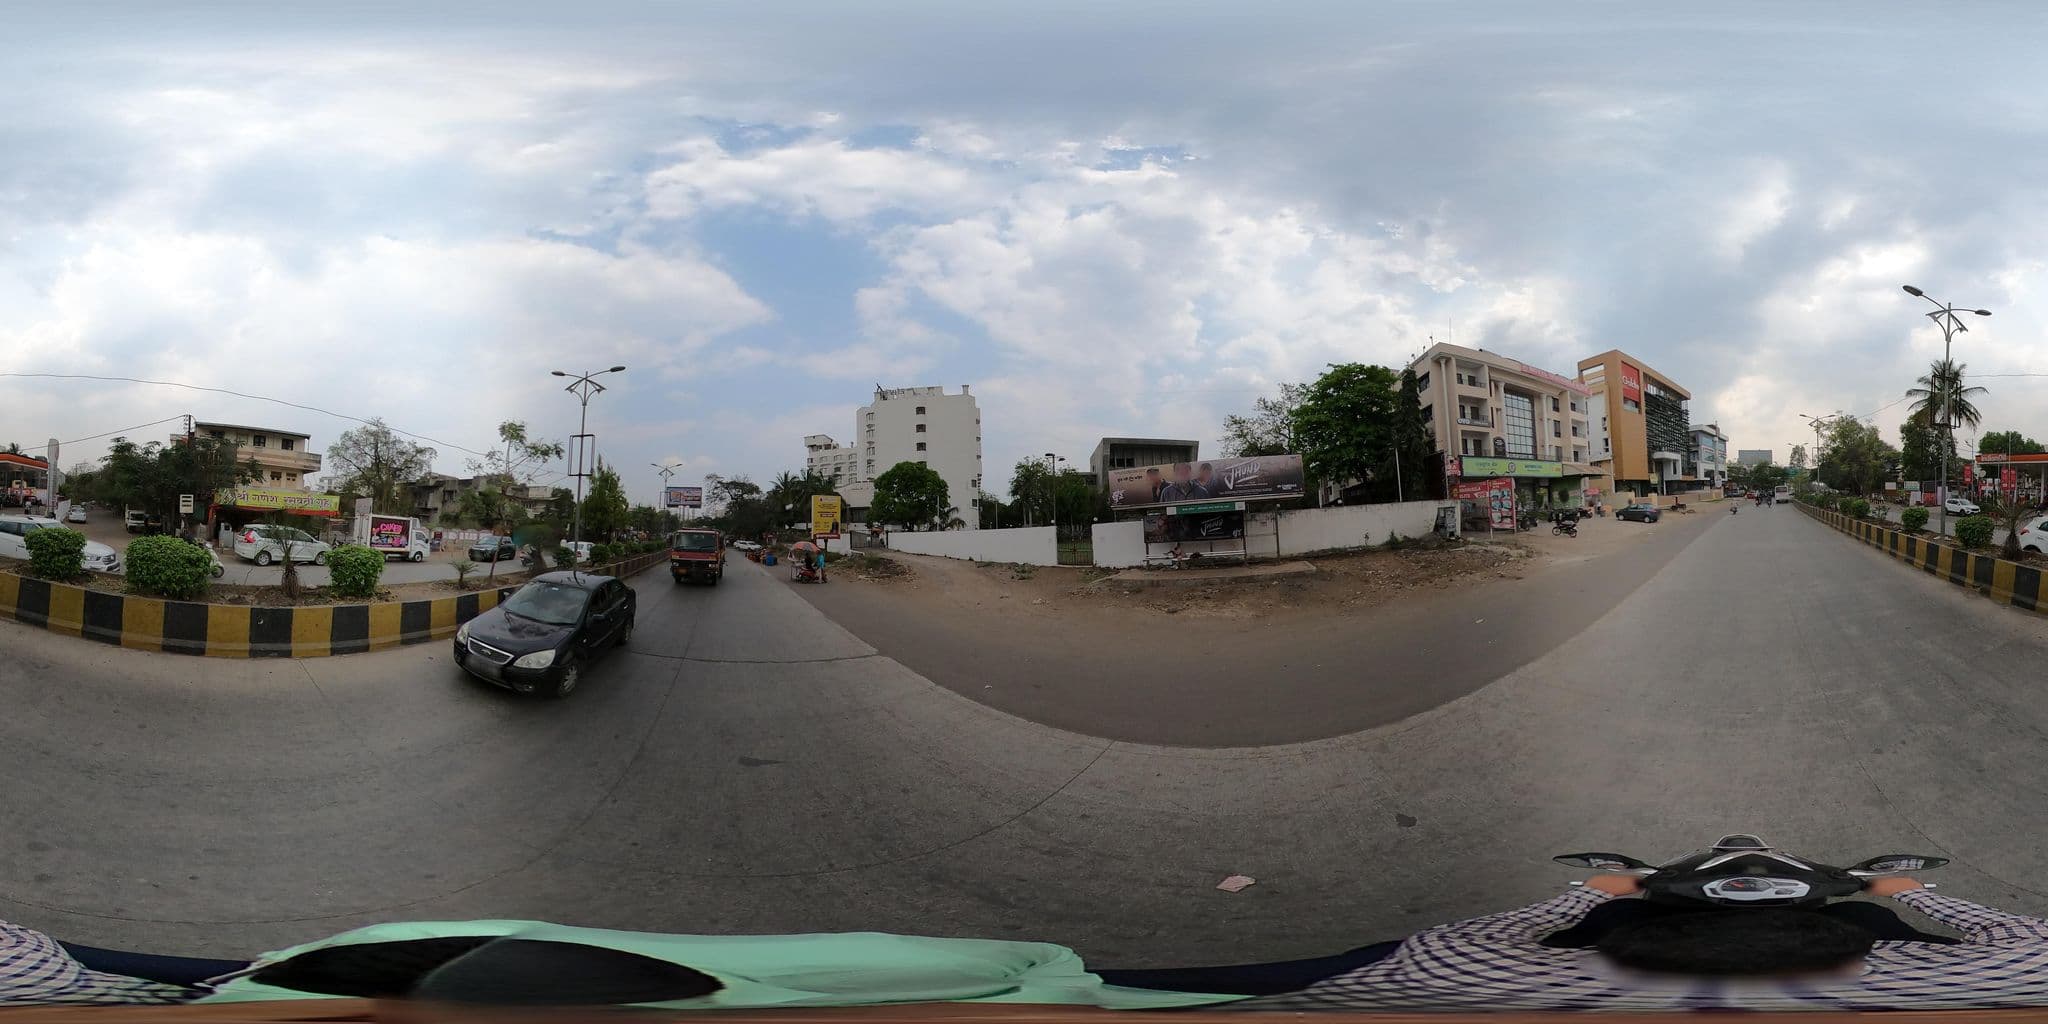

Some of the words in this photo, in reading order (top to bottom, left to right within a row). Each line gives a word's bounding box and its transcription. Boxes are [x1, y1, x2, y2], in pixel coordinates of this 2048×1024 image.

[1225, 458, 1260, 490] JHUND
[239, 491, 248, 502] श्री
[252, 492, 278, 503] गणेश
[1201, 516, 1224, 536] JHUND
